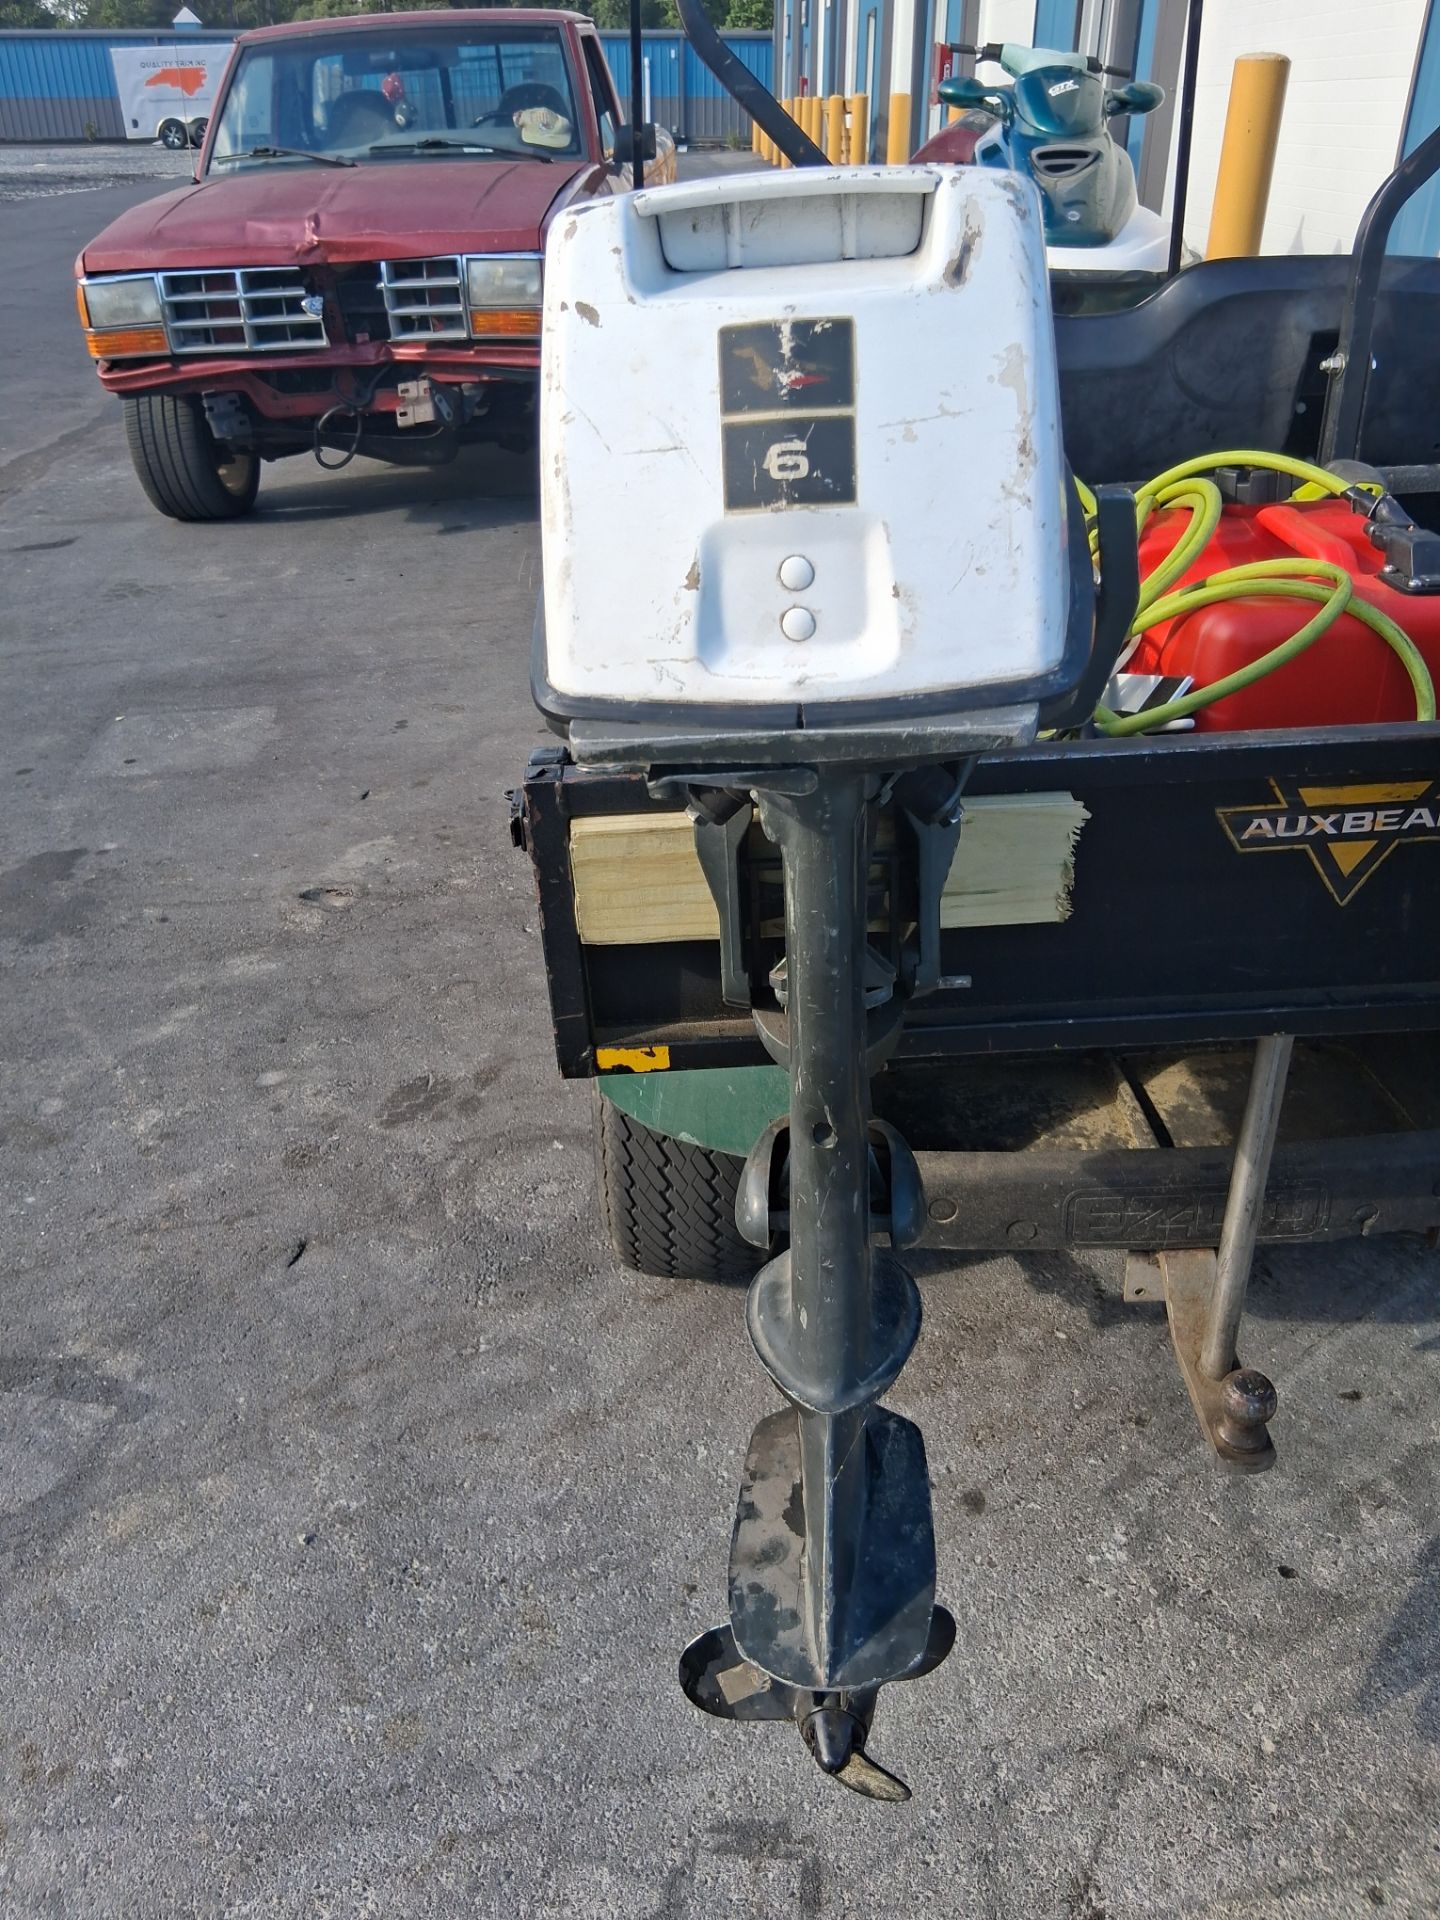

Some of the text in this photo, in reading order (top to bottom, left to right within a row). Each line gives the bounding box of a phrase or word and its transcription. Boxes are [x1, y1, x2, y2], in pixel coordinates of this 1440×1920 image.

[140, 60, 173, 68] QUALITY
[763, 439, 809, 480] 6
[1241, 808, 1440, 840] AUXBEA
